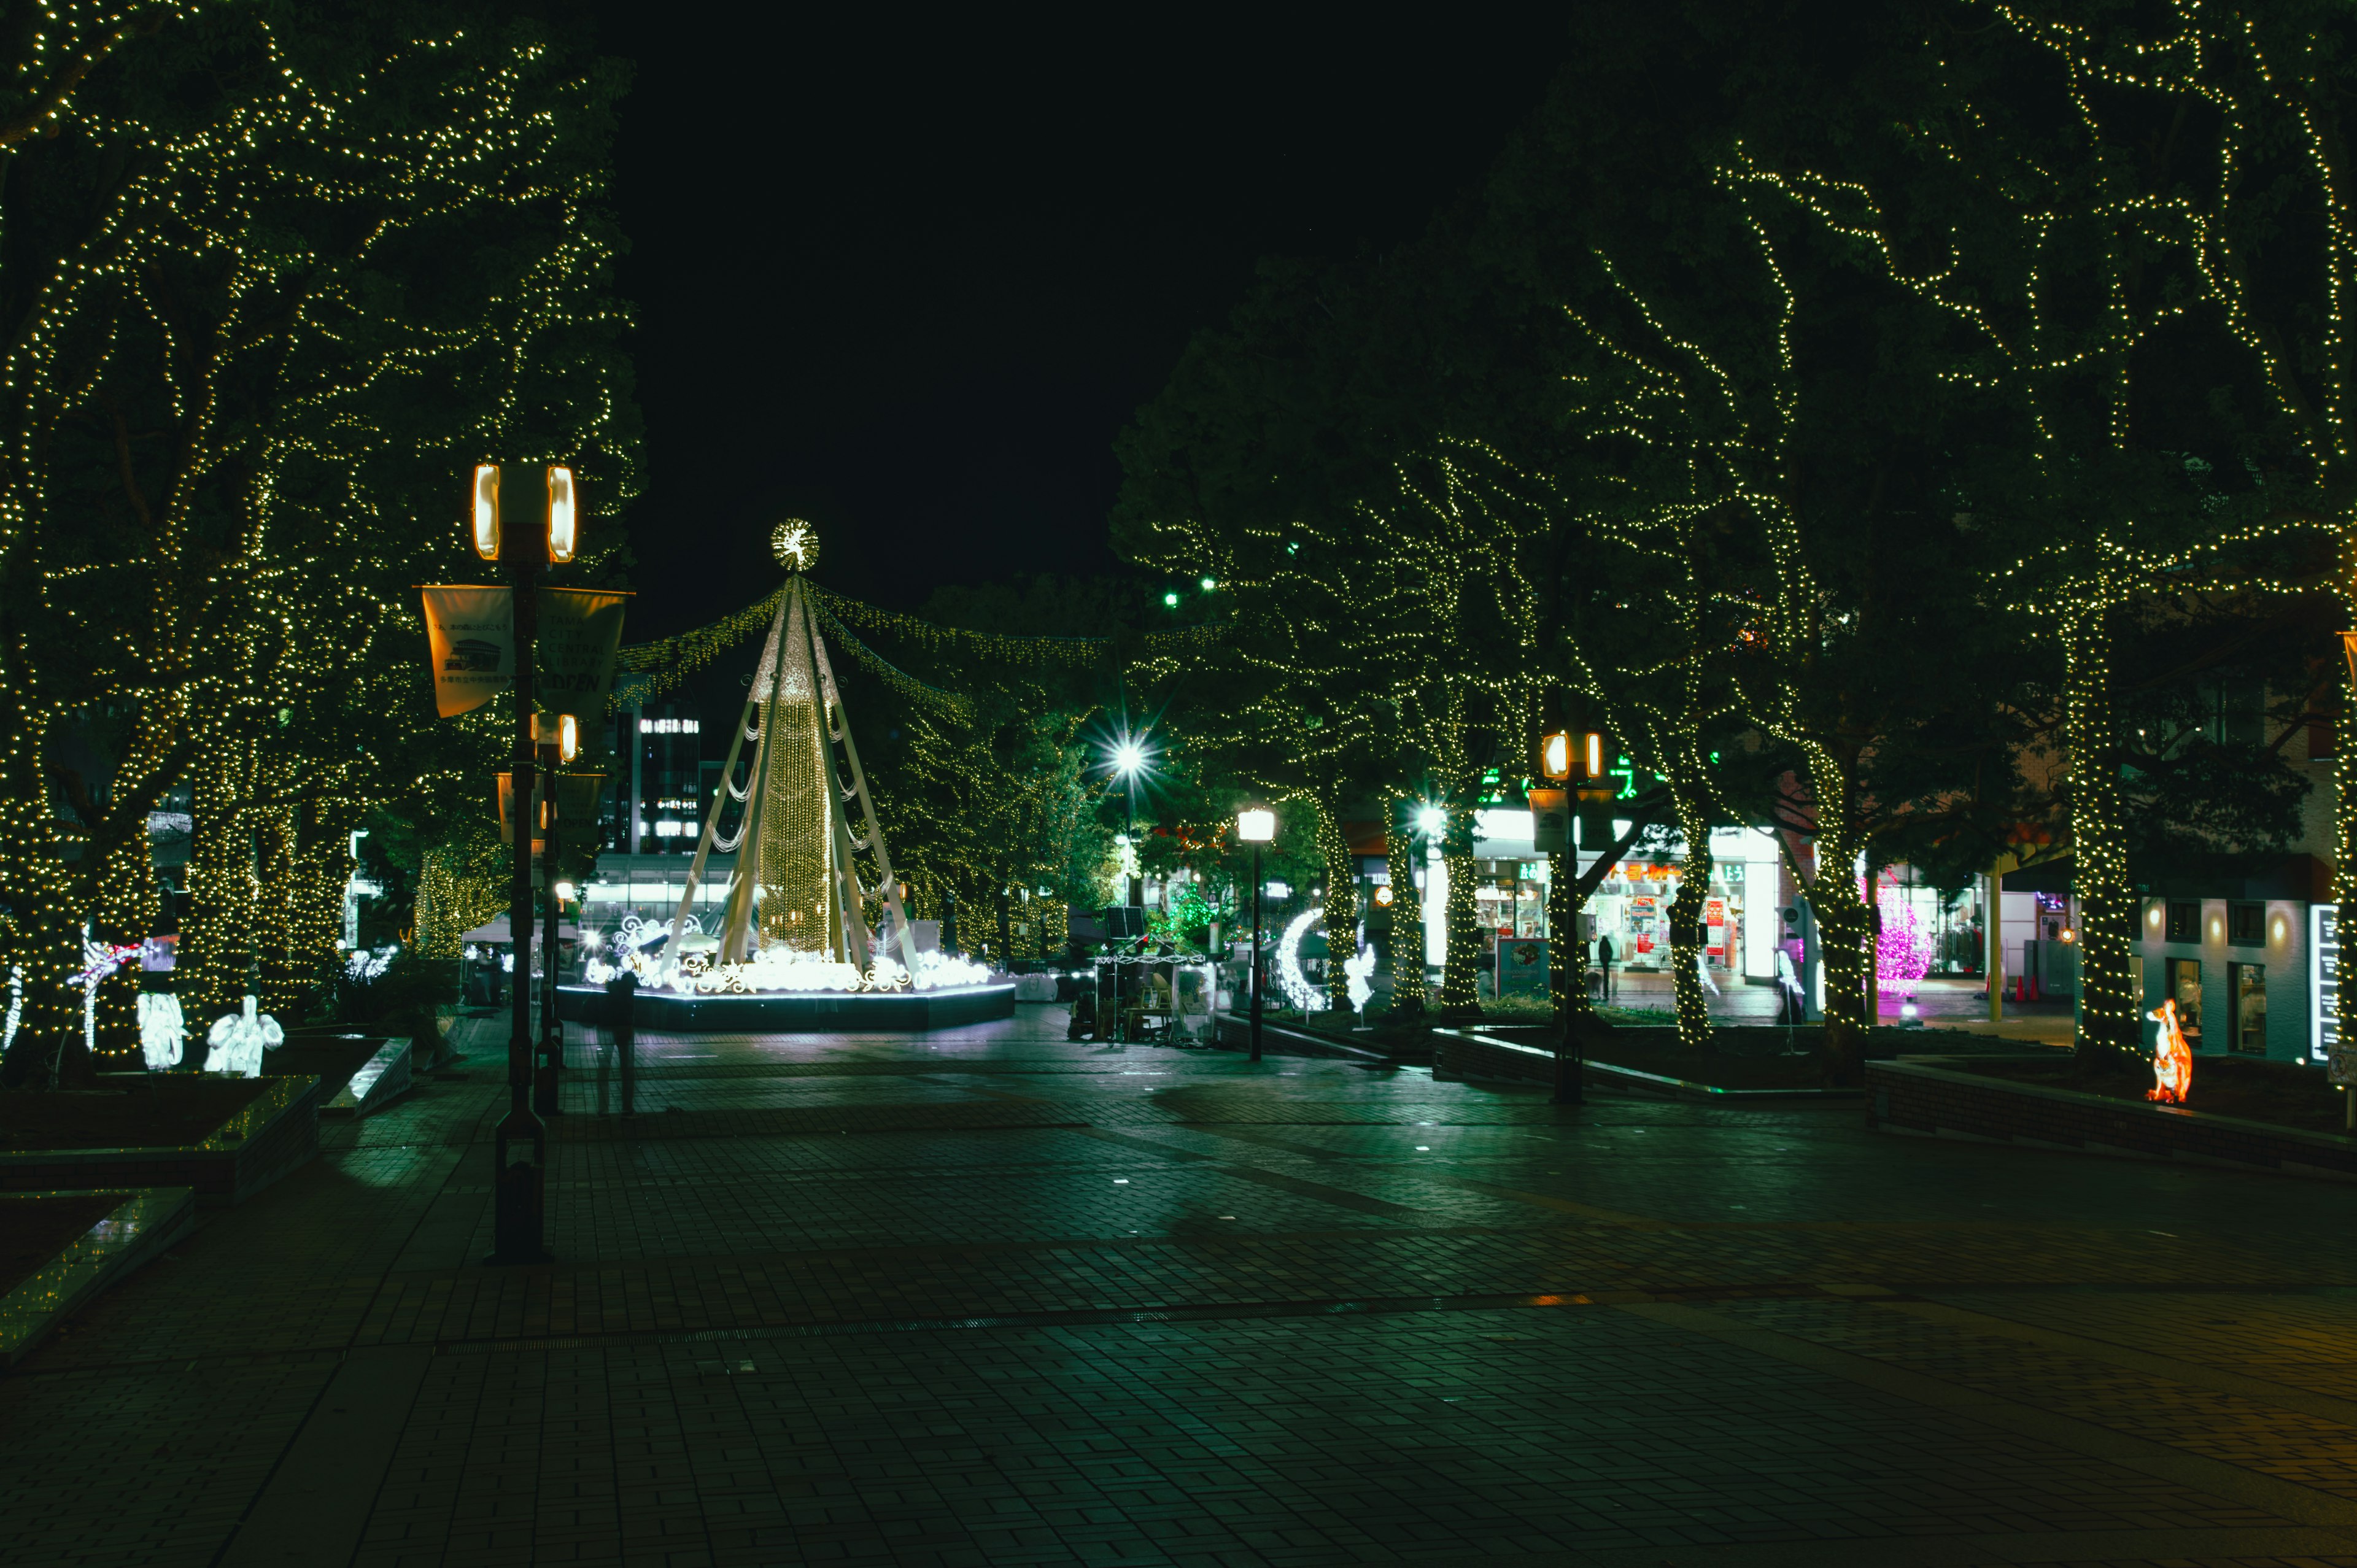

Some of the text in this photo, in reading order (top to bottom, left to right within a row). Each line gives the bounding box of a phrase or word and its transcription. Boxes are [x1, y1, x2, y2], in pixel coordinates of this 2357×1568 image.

[549, 616, 584, 626] TAMA
[549, 629, 583, 639] CITY
[548, 643, 605, 655] CENTRAL
[549, 657, 605, 668] LIBRARY
[552, 673, 600, 692] OPEN
[563, 819, 592, 828] OPEN
[1584, 828, 1612, 838] OPEN
[1603, 864, 1682, 881] トーヨーカドー
